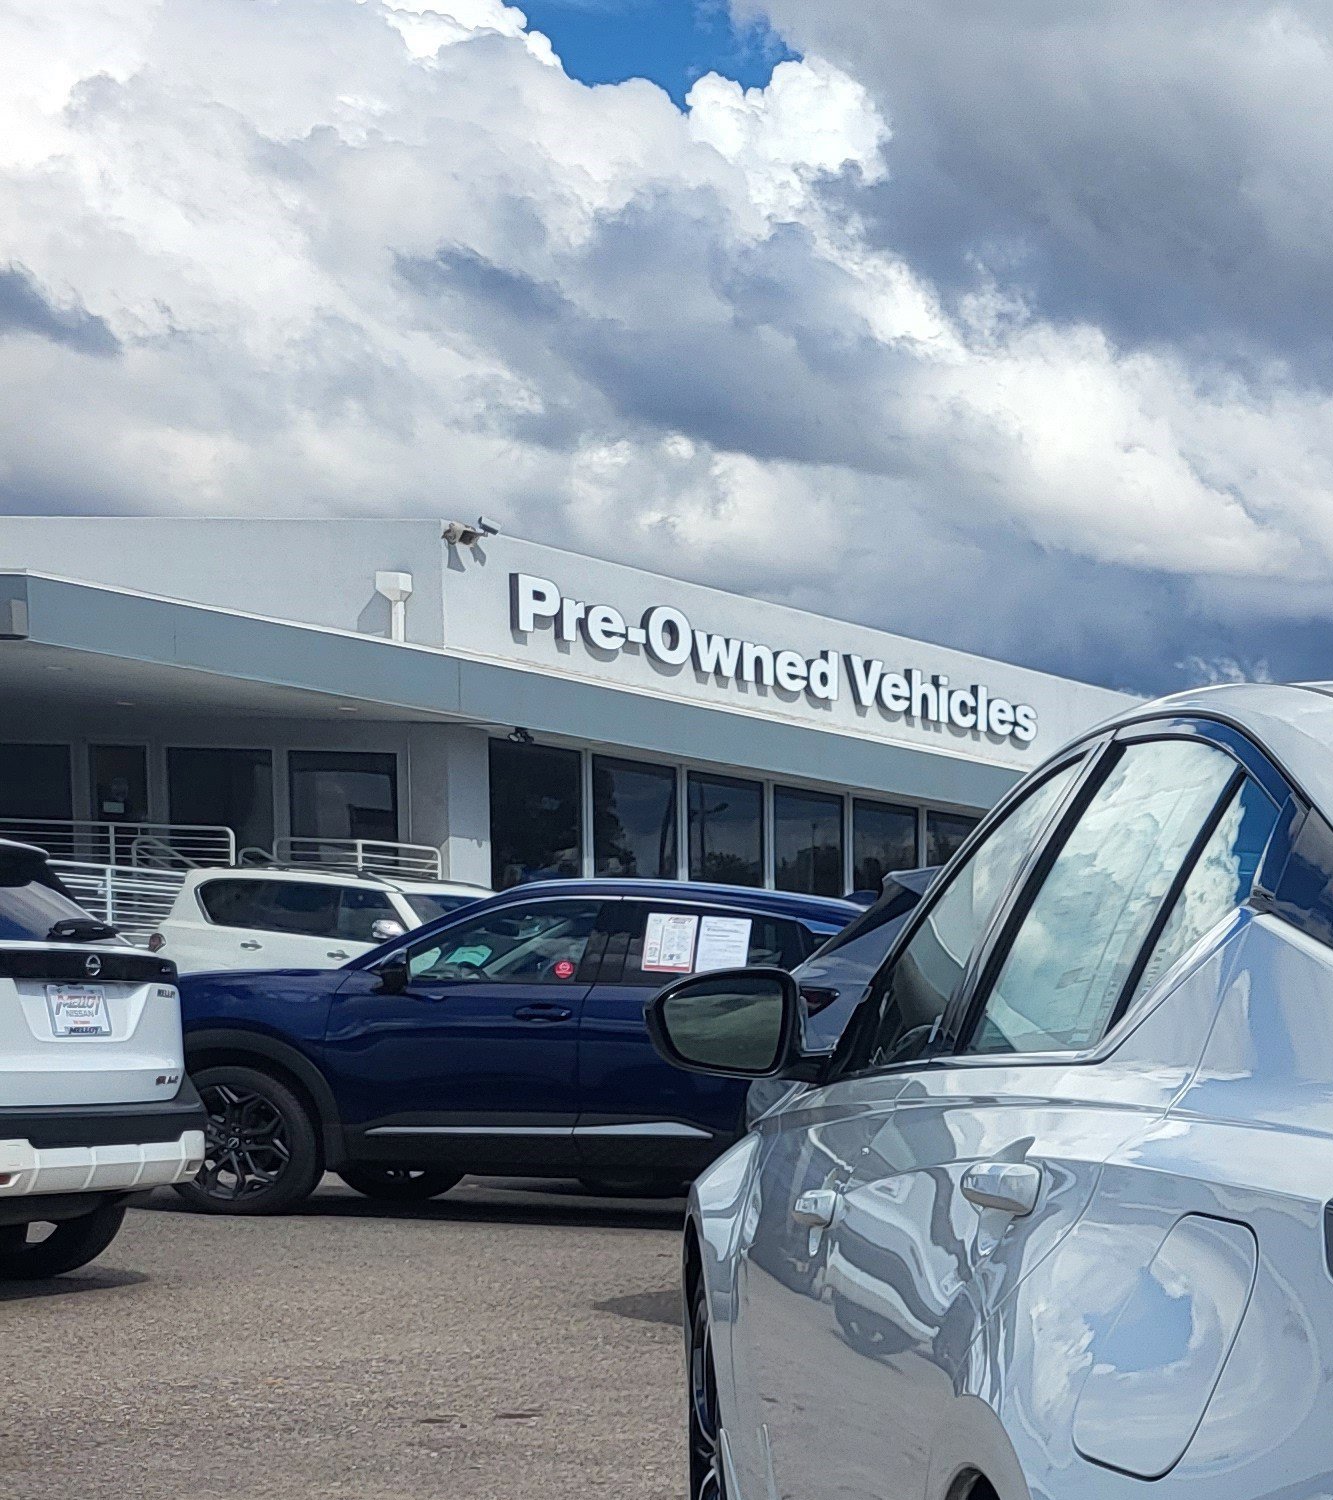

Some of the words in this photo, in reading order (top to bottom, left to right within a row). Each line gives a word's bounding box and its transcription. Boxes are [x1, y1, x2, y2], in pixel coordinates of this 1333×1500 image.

[511, 572, 838, 701] Pre-Owned
[845, 653, 1038, 742] Vehicles
[55, 995, 101, 1016] MELLOY
